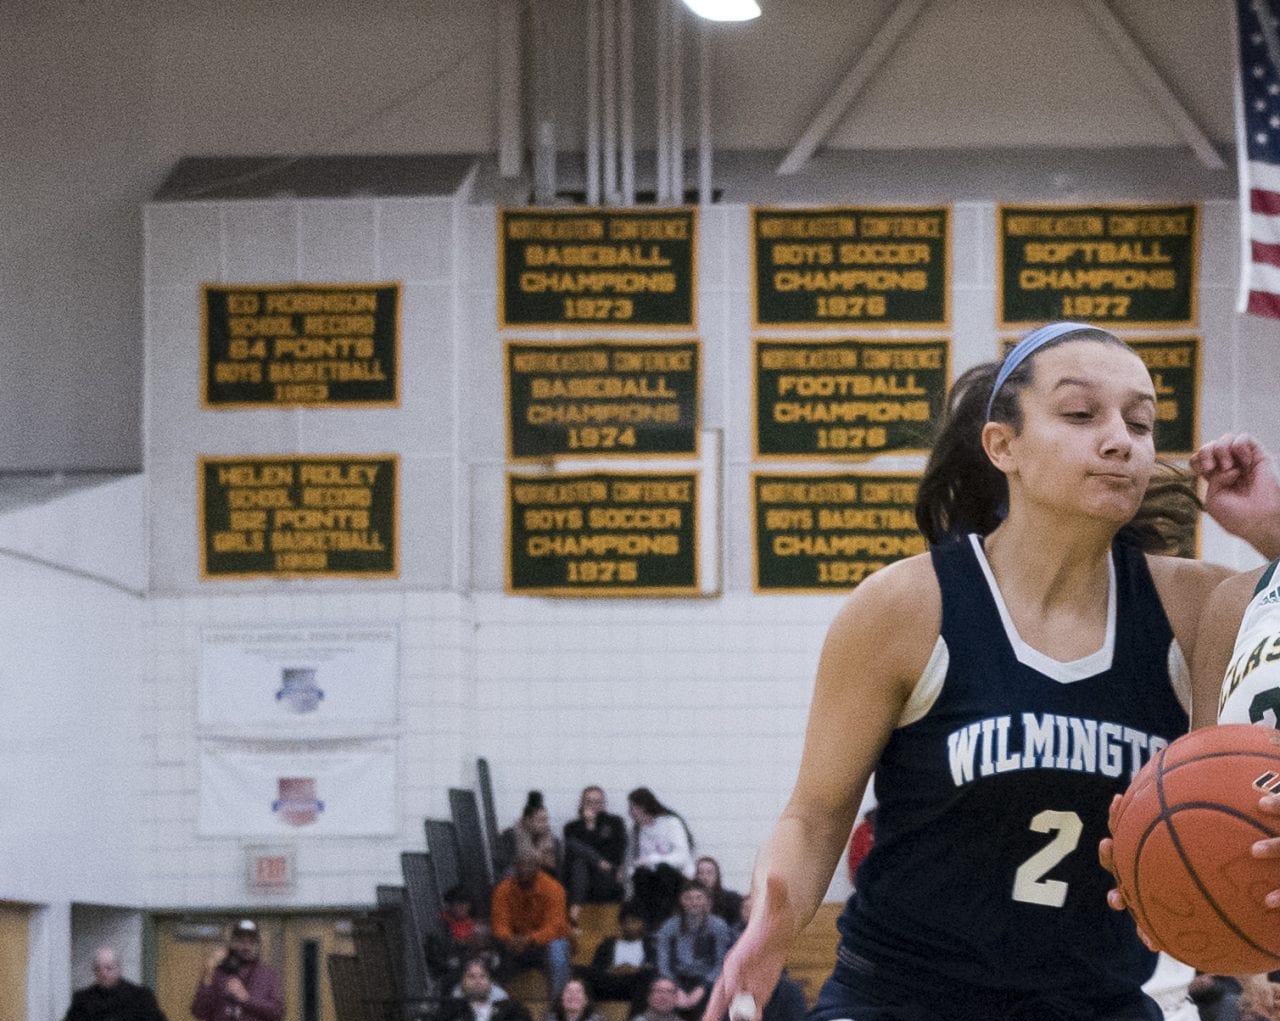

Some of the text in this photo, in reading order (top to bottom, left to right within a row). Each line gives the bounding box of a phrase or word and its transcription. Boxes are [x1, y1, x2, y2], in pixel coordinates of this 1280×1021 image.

[525, 246, 672, 266] BASEBALL
[839, 243, 930, 264] SOCCER
[1024, 242, 1167, 262] SOFTBALL
[521, 273, 676, 291] CHAMPIONS
[774, 271, 927, 290] CHAMPIONS
[1019, 269, 1174, 289] CHAMPIONS
[565, 298, 634, 319] 1973
[1062, 295, 1130, 316] 1977
[274, 338, 374, 357] POINTS
[531, 378, 676, 398] BASEBALL
[778, 375, 926, 395] FOOTBALL
[527, 404, 680, 422] CHAMPIONS
[774, 402, 930, 421] CHAMPIONS
[569, 427, 636, 447] 1974
[274, 510, 370, 528] POINTS
[589, 508, 682, 529] SOCCER
[765, 508, 915, 530] BOYS BASKETBA
[528, 535, 679, 555] CHAMPIONS
[1011, 808, 1085, 908] 2
